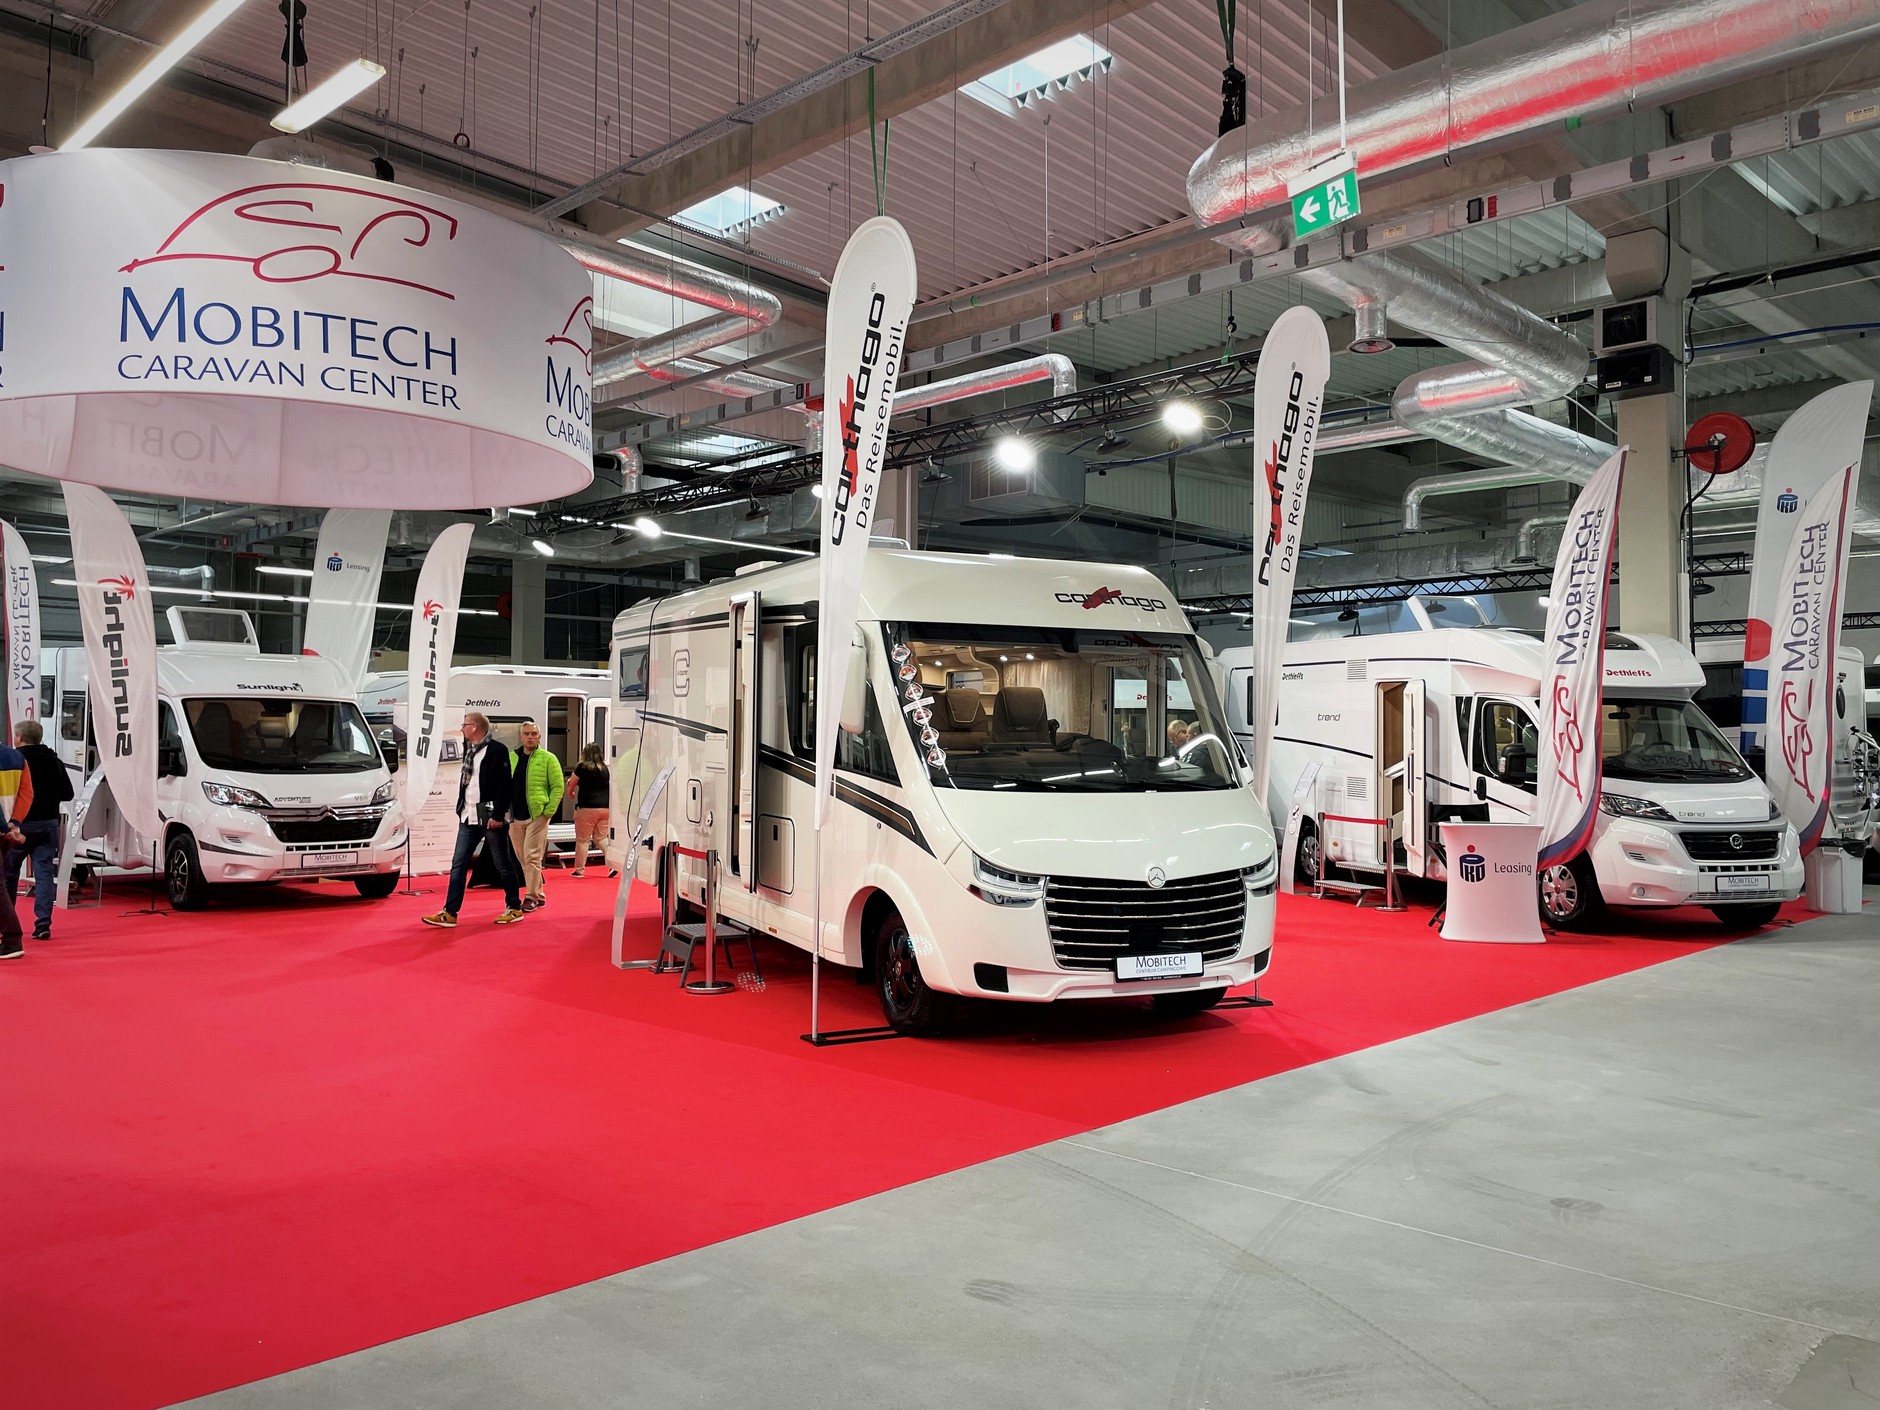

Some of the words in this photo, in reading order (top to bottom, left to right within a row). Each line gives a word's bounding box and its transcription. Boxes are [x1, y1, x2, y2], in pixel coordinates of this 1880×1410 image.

[119, 286, 458, 376] MOBITECH
[117, 354, 305, 387] CARAVAN
[320, 365, 461, 411] CENTER
[546, 414, 592, 458] CARAVA
[855, 483, 873, 529] Das
[866, 320, 904, 474] Reisemobil.
[1280, 534, 1296, 574] Das
[1288, 396, 1319, 526] Reisemobil.
[1814, 519, 1831, 585] CENTER
[1555, 510, 1595, 665] MOBITECH
[1781, 524, 1822, 672] MOBITECH
[1808, 593, 1822, 670] CARAVAN
[1605, 669, 1652, 678] Dethleffs
[465, 699, 501, 707] Dethleffs
[1317, 713, 1341, 722] trend
[1678, 810, 1706, 818] trend
[314, 854, 347, 862] MOBITECH
[1494, 862, 1532, 876] Leasing
[1727, 877, 1759, 885] MOBITECH
[1135, 956, 1187, 969] MOBITECH
